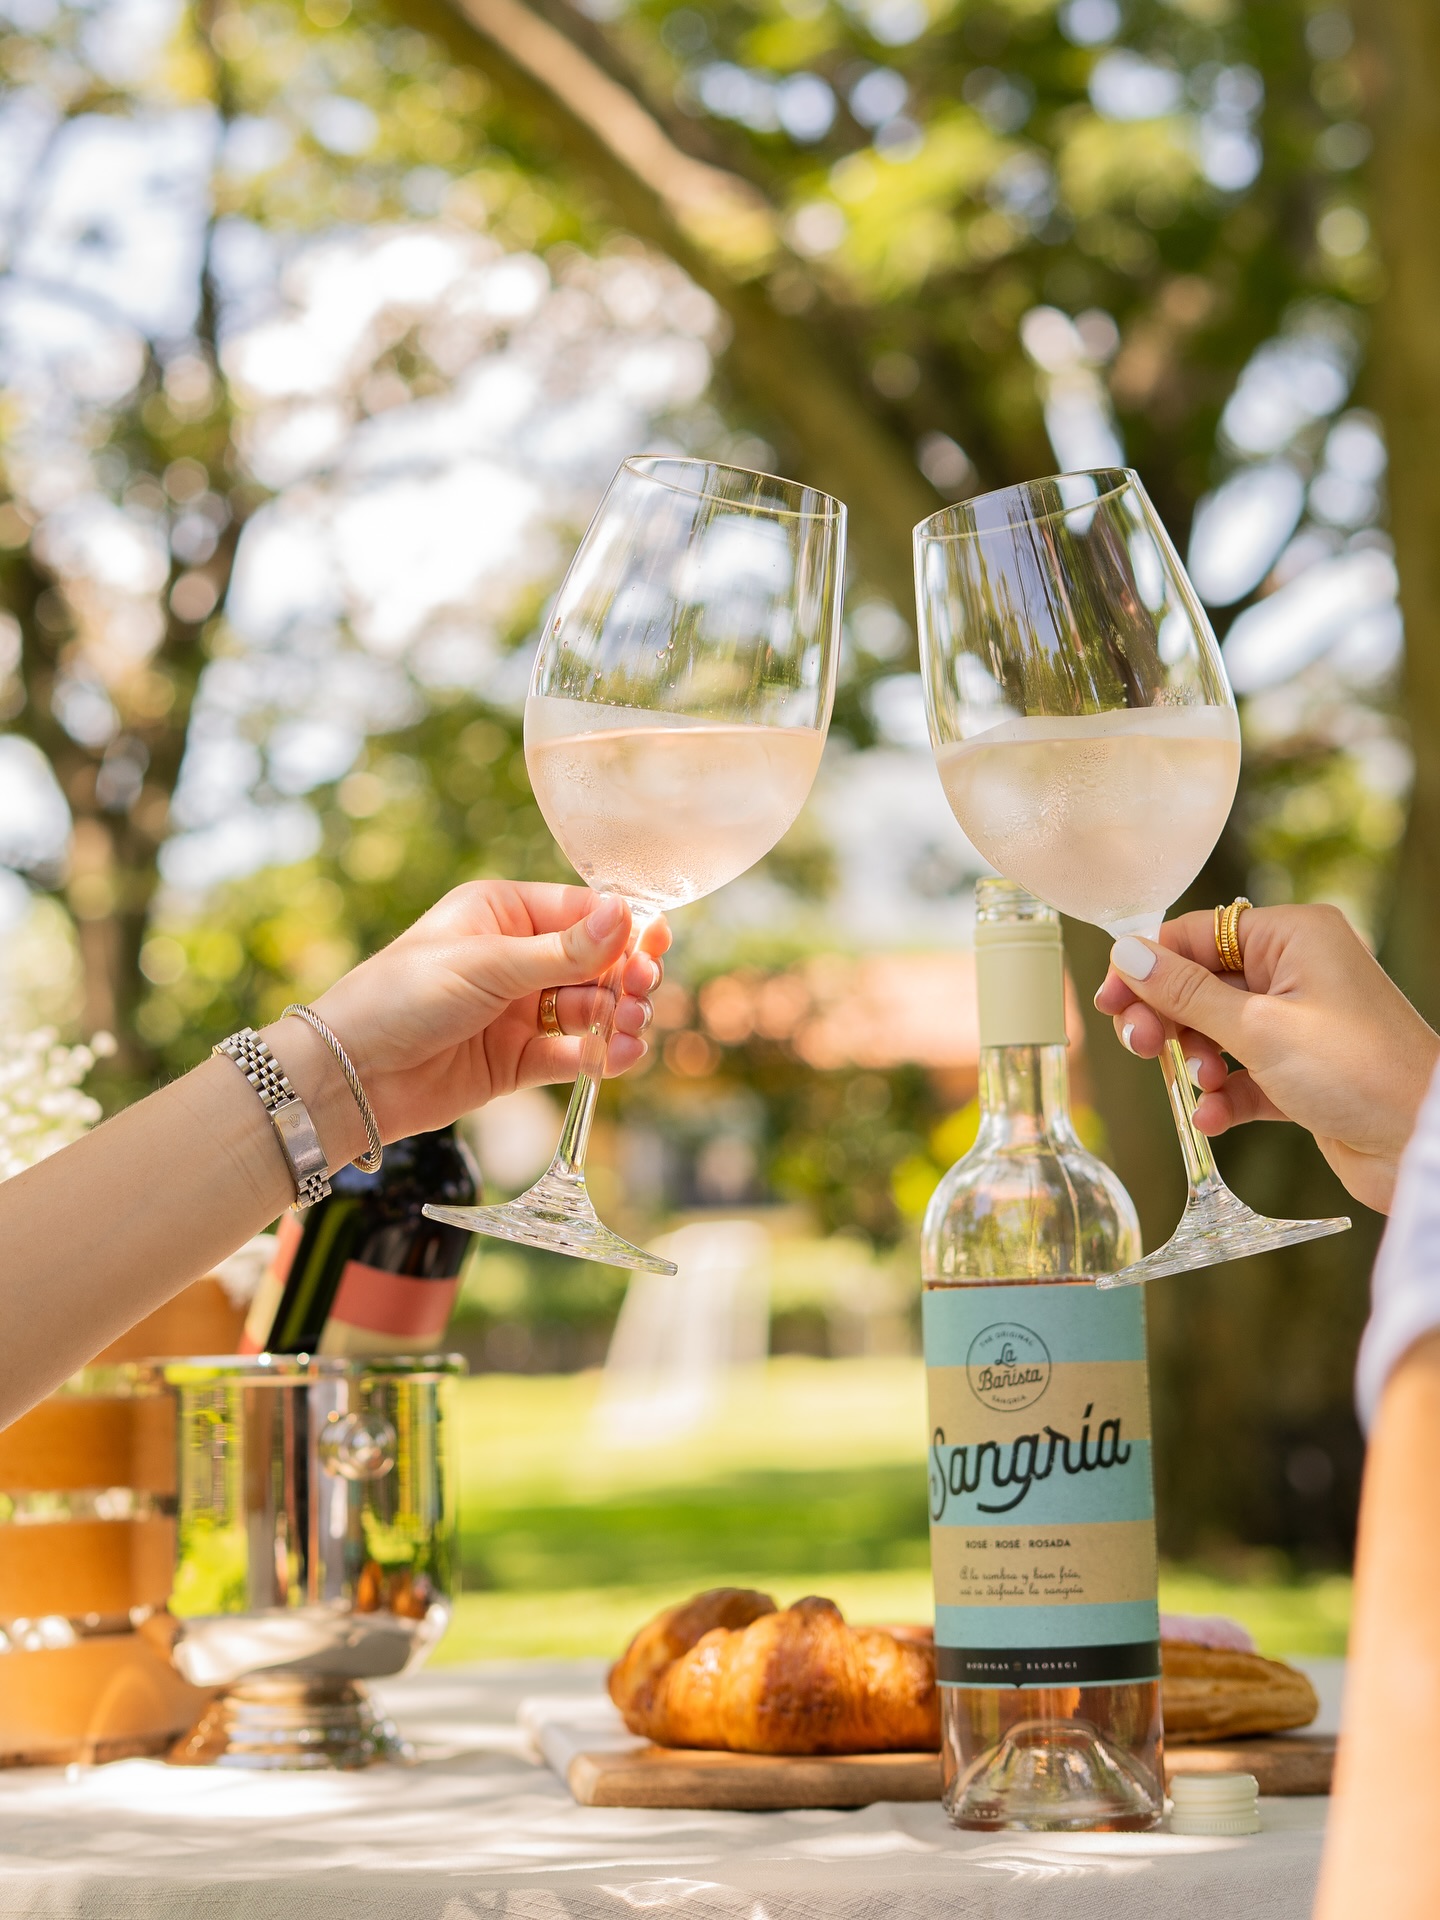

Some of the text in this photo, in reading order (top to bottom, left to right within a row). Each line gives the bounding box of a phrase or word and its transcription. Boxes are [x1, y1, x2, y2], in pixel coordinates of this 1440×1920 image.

[994, 1331, 1033, 1347] ORIGINAL
[994, 1342, 1017, 1368] La
[977, 1366, 1043, 1392] Bañista
[929, 1402, 1131, 1521] Sangría
[1028, 1538, 1071, 1548] ROSADA
[969, 1567, 979, 1580] la
[982, 1567, 1018, 1580] sombra
[1021, 1574, 1029, 1585] y
[1033, 1566, 1056, 1579] bien
[986, 1582, 1025, 1601] disfruta
[1028, 1582, 1040, 1595] la
[966, 1661, 1078, 1671] BODEGAS ELOSEGI
